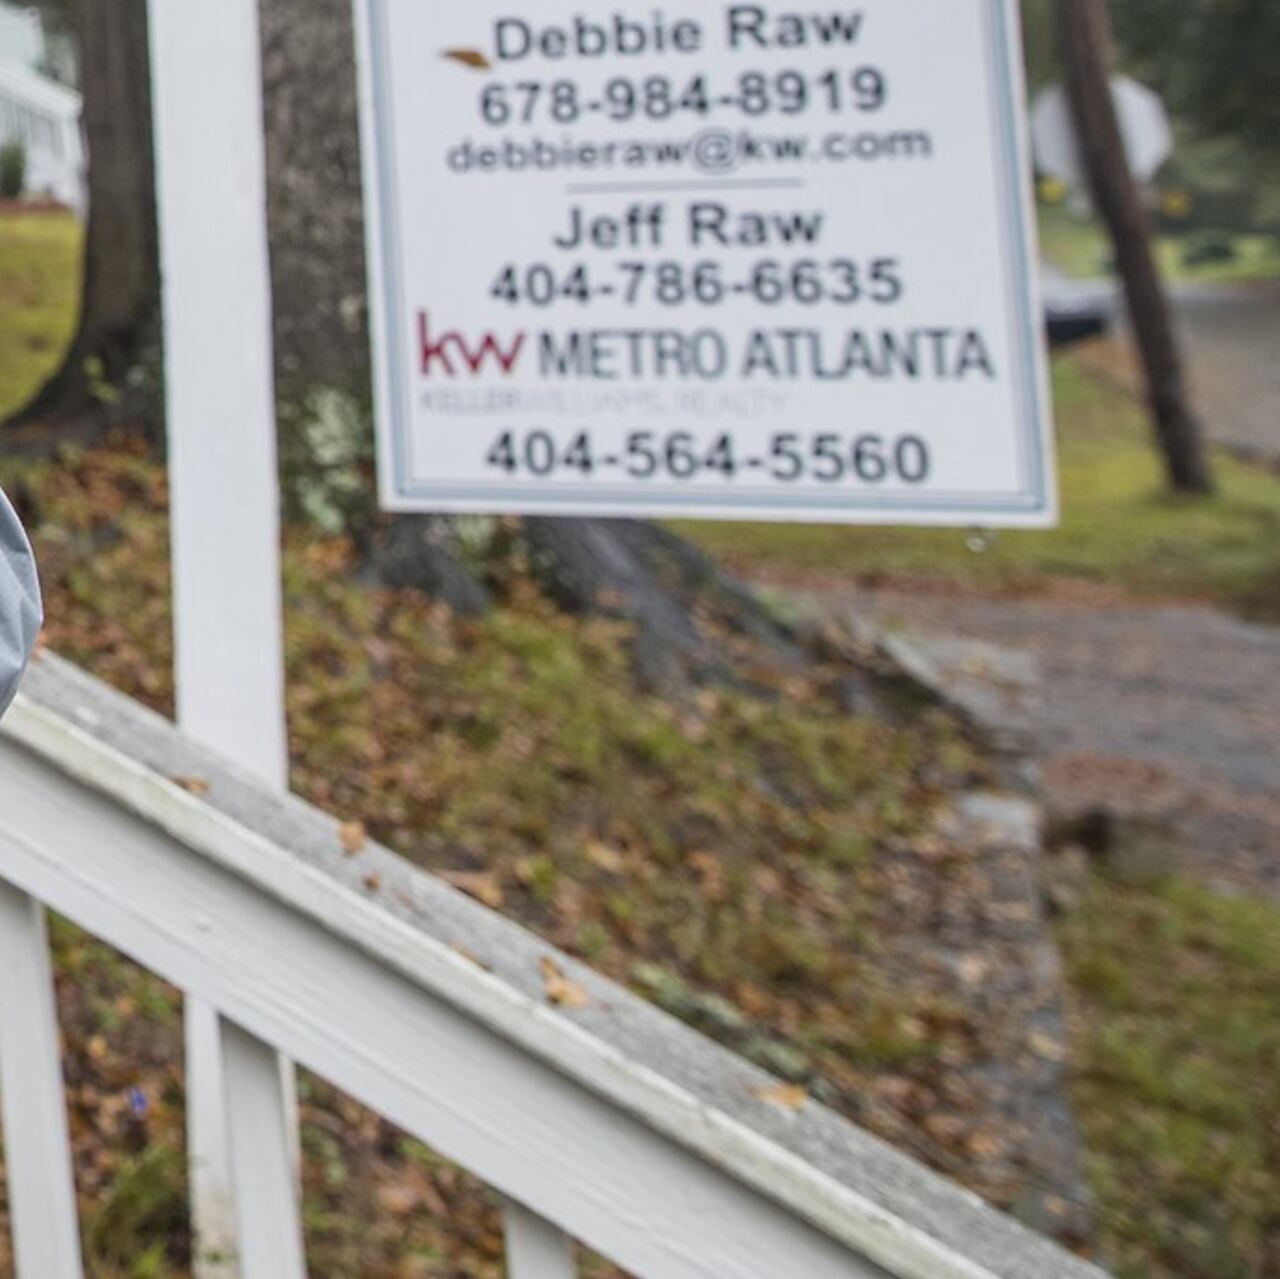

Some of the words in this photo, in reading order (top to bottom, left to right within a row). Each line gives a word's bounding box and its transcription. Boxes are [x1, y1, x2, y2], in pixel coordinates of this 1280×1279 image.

[494, 13, 702, 61] Debbie
[726, 5, 862, 48] Raw
[479, 67, 887, 125] 678-984-8919
[447, 127, 932, 174] debbieraw@kw.com
[554, 203, 663, 250] Jeff
[688, 202, 823, 246] Raw
[490, 258, 902, 307] 404-786-6635
[417, 310, 526, 376] kw
[538, 328, 727, 380] METRO
[741, 327, 996, 380] ATLANTA
[486, 430, 930, 484] 404-564-5560
